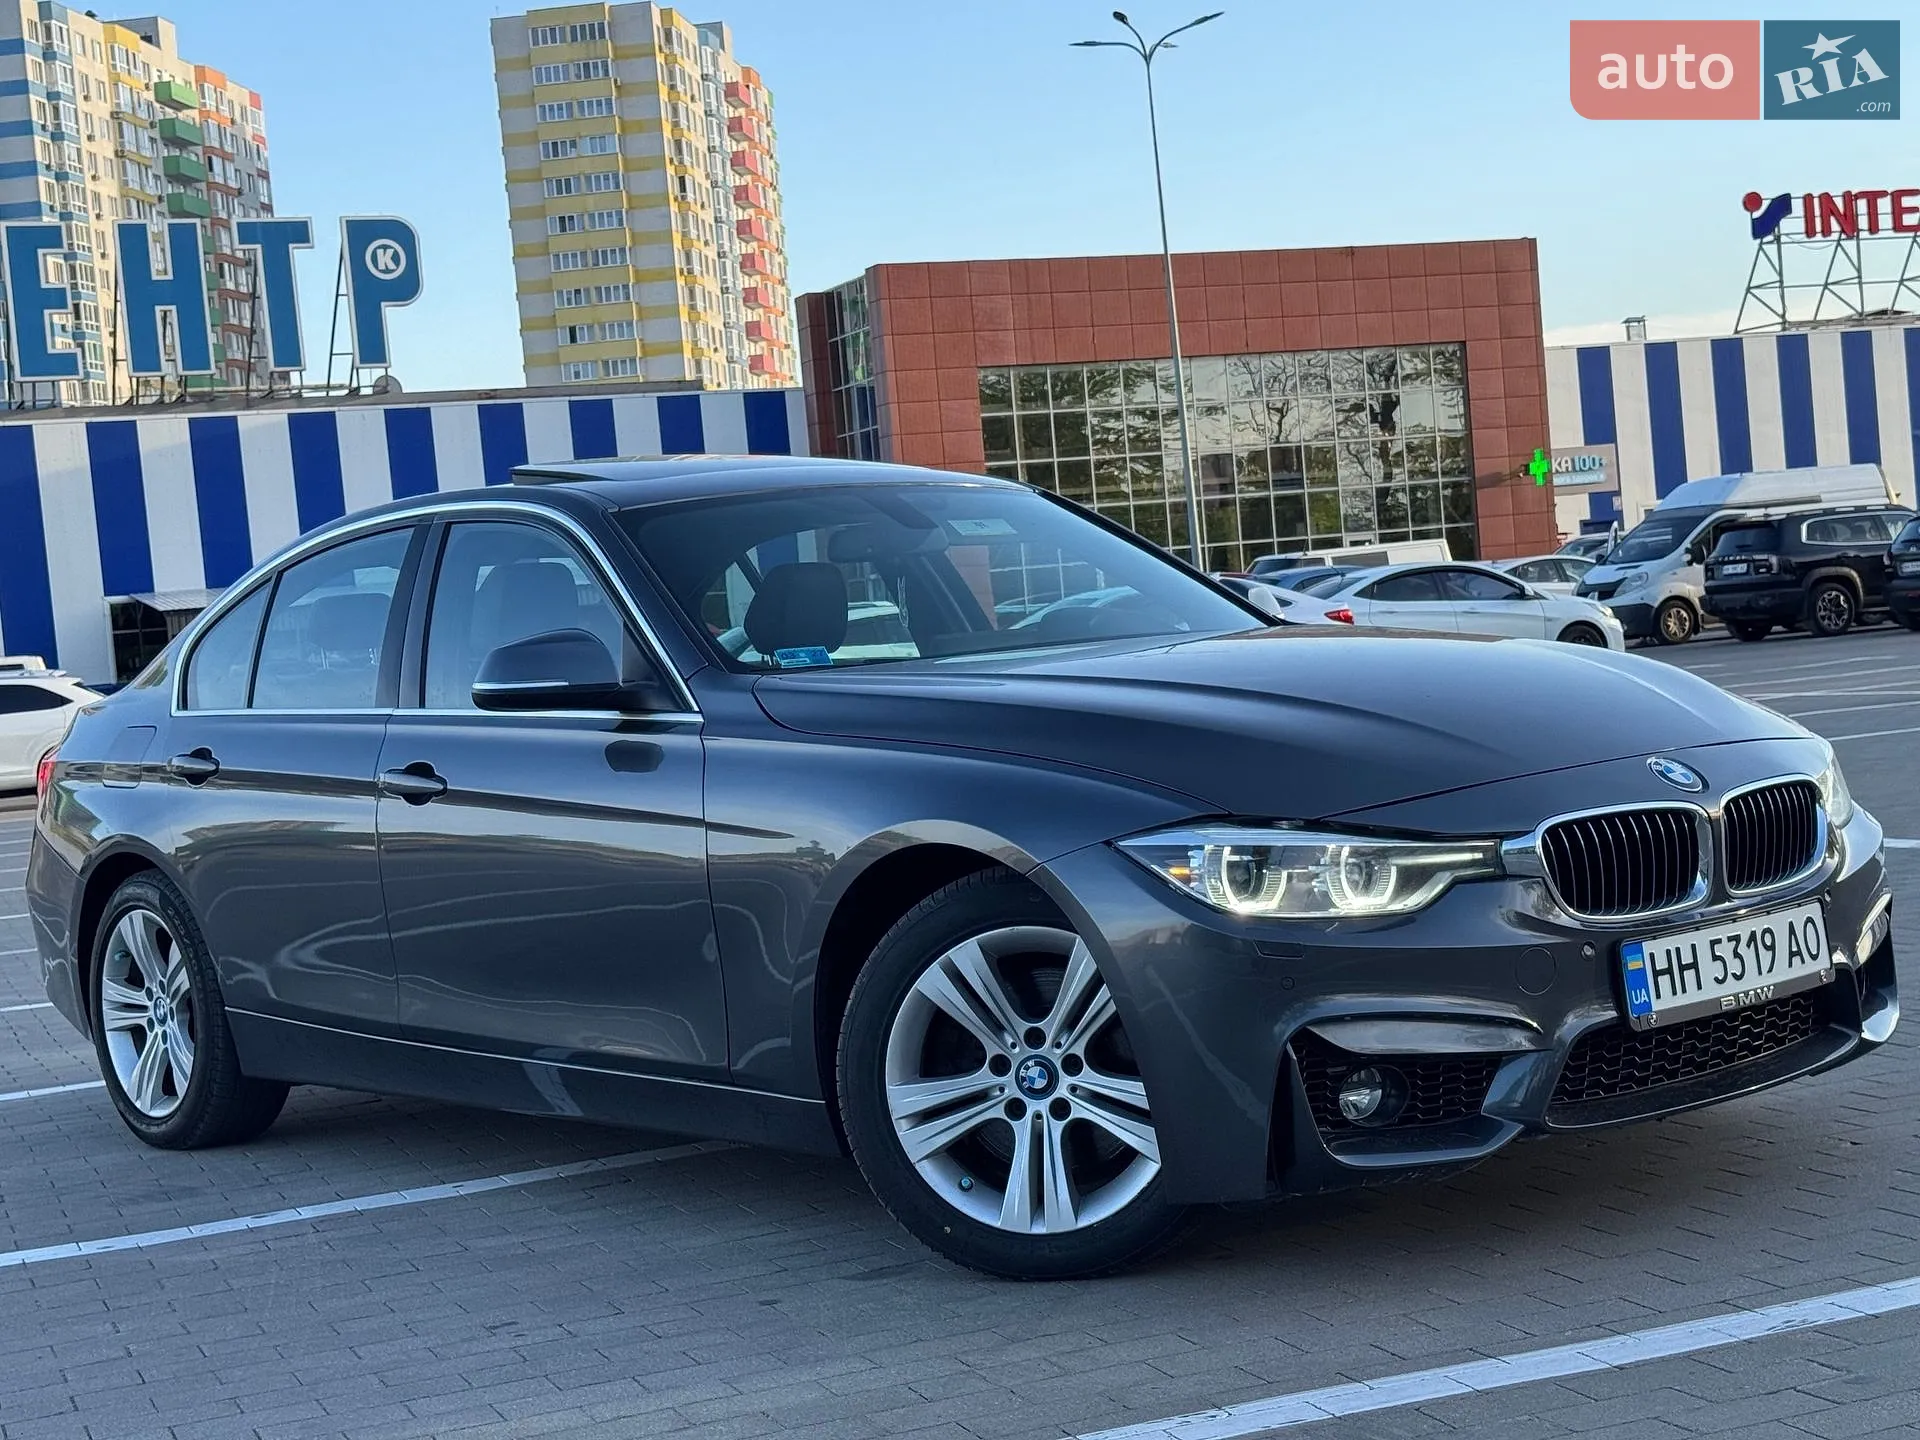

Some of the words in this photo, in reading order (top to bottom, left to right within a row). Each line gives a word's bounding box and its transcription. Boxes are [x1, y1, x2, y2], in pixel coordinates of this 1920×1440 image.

[1803, 189, 1920, 239] INTE
[1649, 943, 1703, 999] HH
[1709, 926, 1777, 985] 5319
[1787, 915, 1821, 969] AO
[1631, 988, 1650, 1005] UA
[1720, 985, 1775, 1011] BMW
